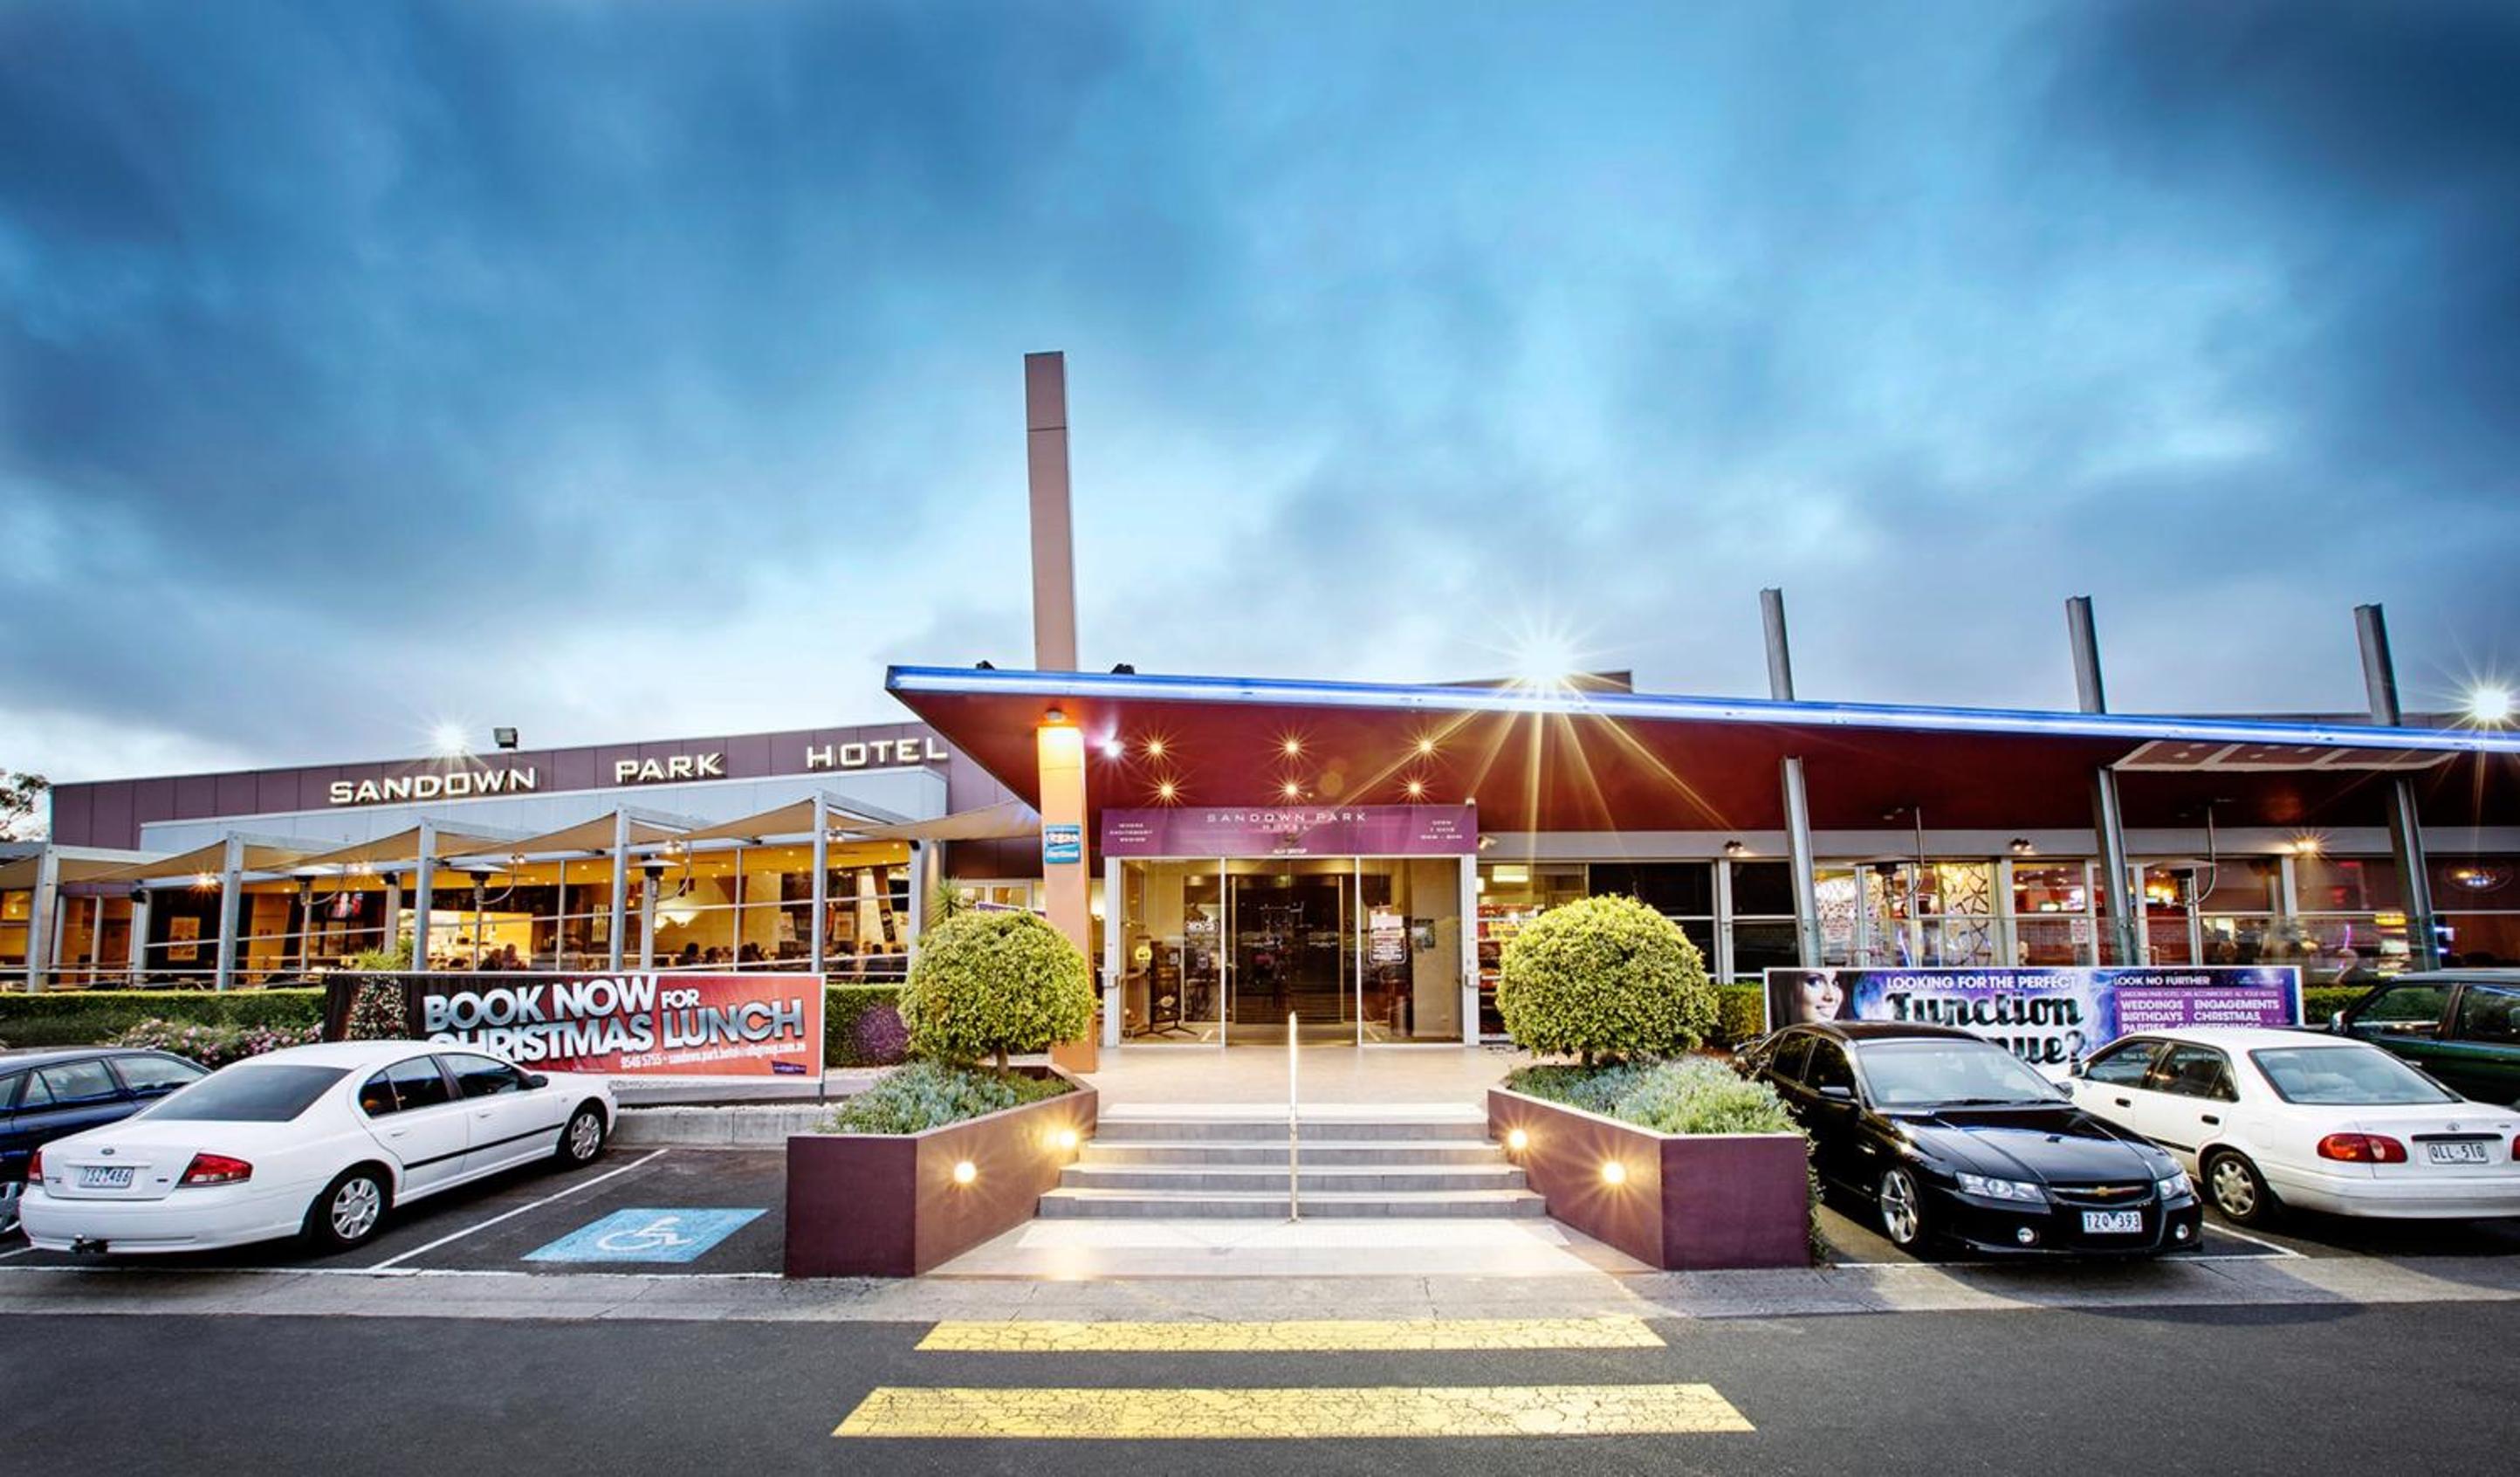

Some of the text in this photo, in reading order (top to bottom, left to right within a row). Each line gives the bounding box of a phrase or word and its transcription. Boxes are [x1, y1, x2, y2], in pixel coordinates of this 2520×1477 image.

[330, 737, 949, 804] SANDOWN PARK HOTEL
[1207, 813, 1366, 822] SANDOWN PARK
[1886, 975, 2076, 990] LOOKING FOR THE PERFECT
[2113, 976, 2210, 986] LOOK NO FURTHER
[424, 974, 699, 1033] BOOK NOW FOR
[1886, 992, 2084, 1027] Function
[2120, 999, 2280, 1010] WEDDINGS ENGAGEMENTS
[663, 998, 805, 1049] LUNCH
[2121, 1011, 2262, 1021] BIRTHDAYS CHRISTMAS
